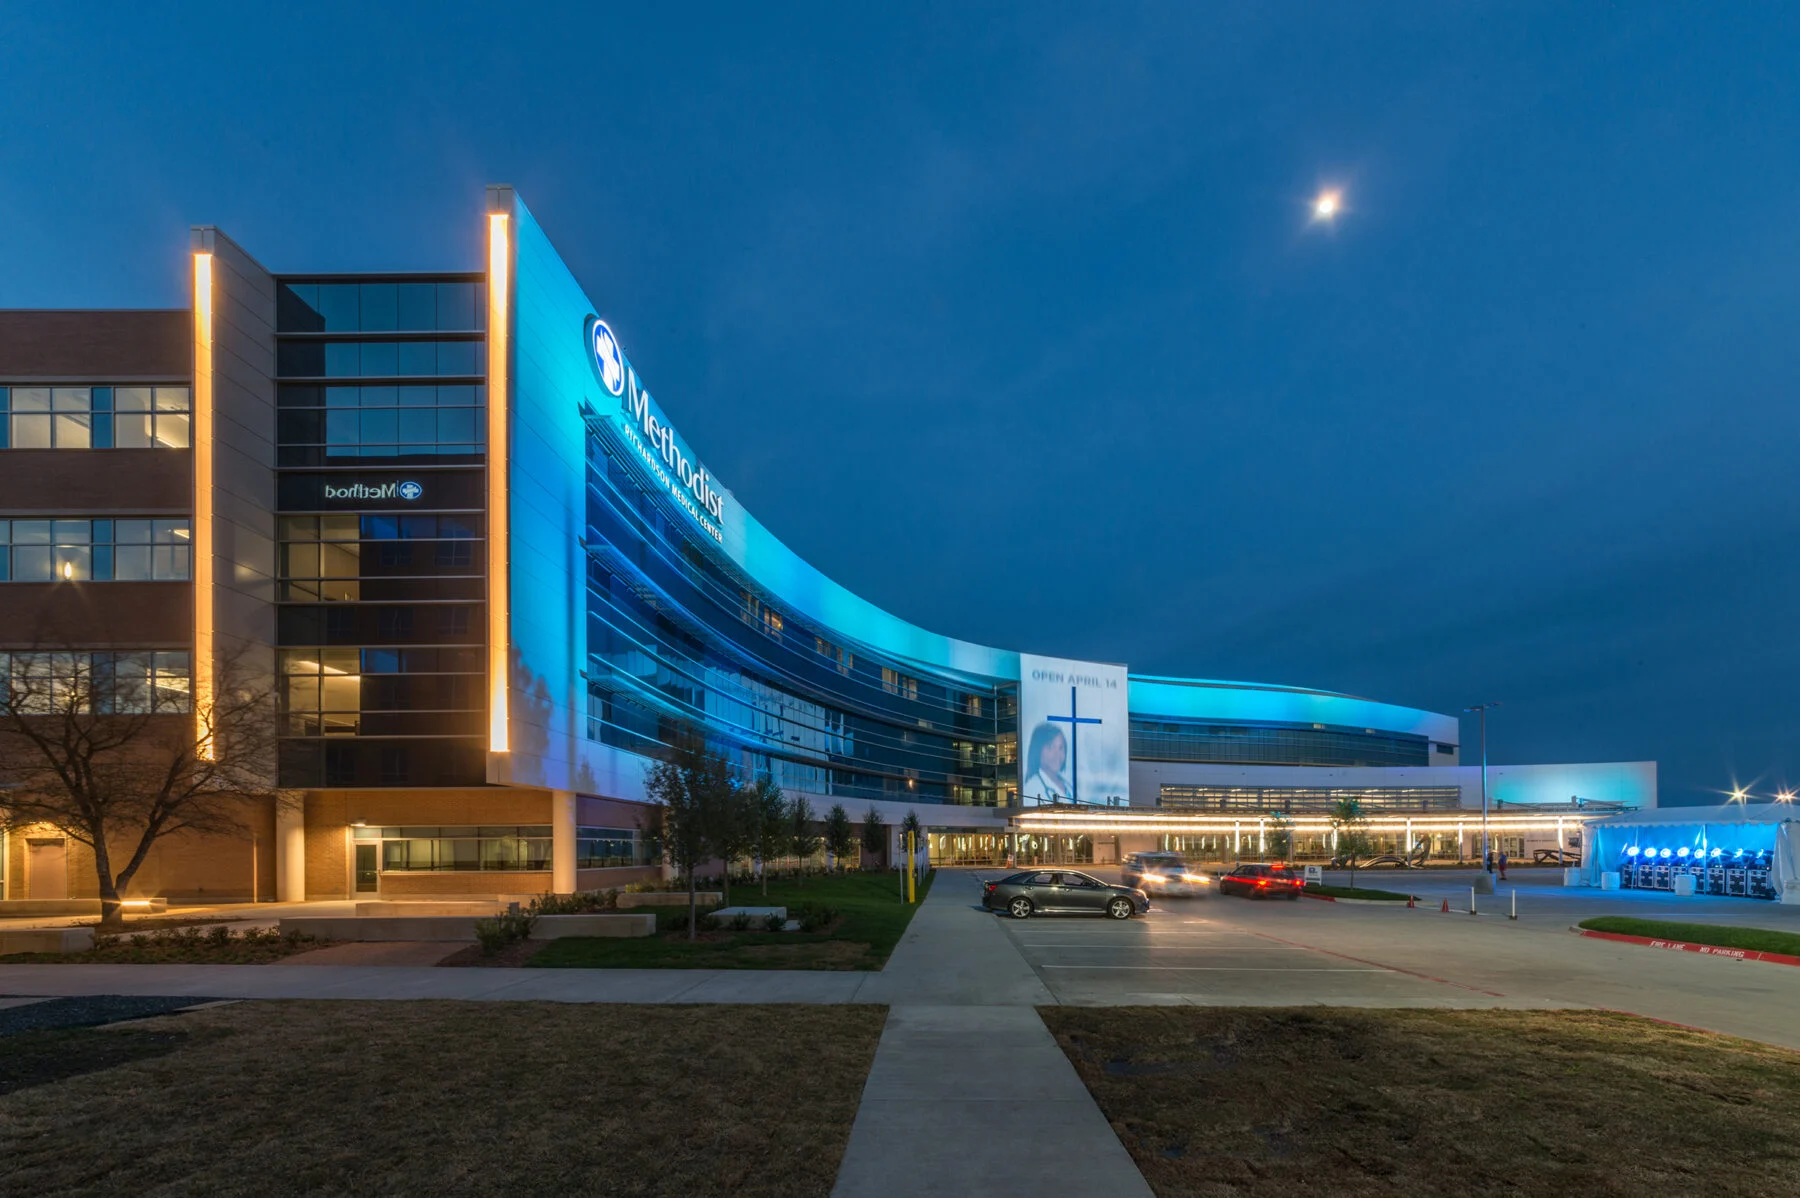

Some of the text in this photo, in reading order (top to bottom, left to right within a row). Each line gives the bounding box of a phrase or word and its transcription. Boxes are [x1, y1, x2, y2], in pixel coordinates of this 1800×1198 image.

[628, 367, 724, 525] Methodist
[624, 424, 723, 544] RICHARDSON MEDICAL CENTER
[1032, 669, 1117, 689] OPEN APRIL 14
[1650, 940, 1666, 949] FIRE
[1667, 943, 1686, 951] LANE
[1712, 948, 1745, 958] PARKING
